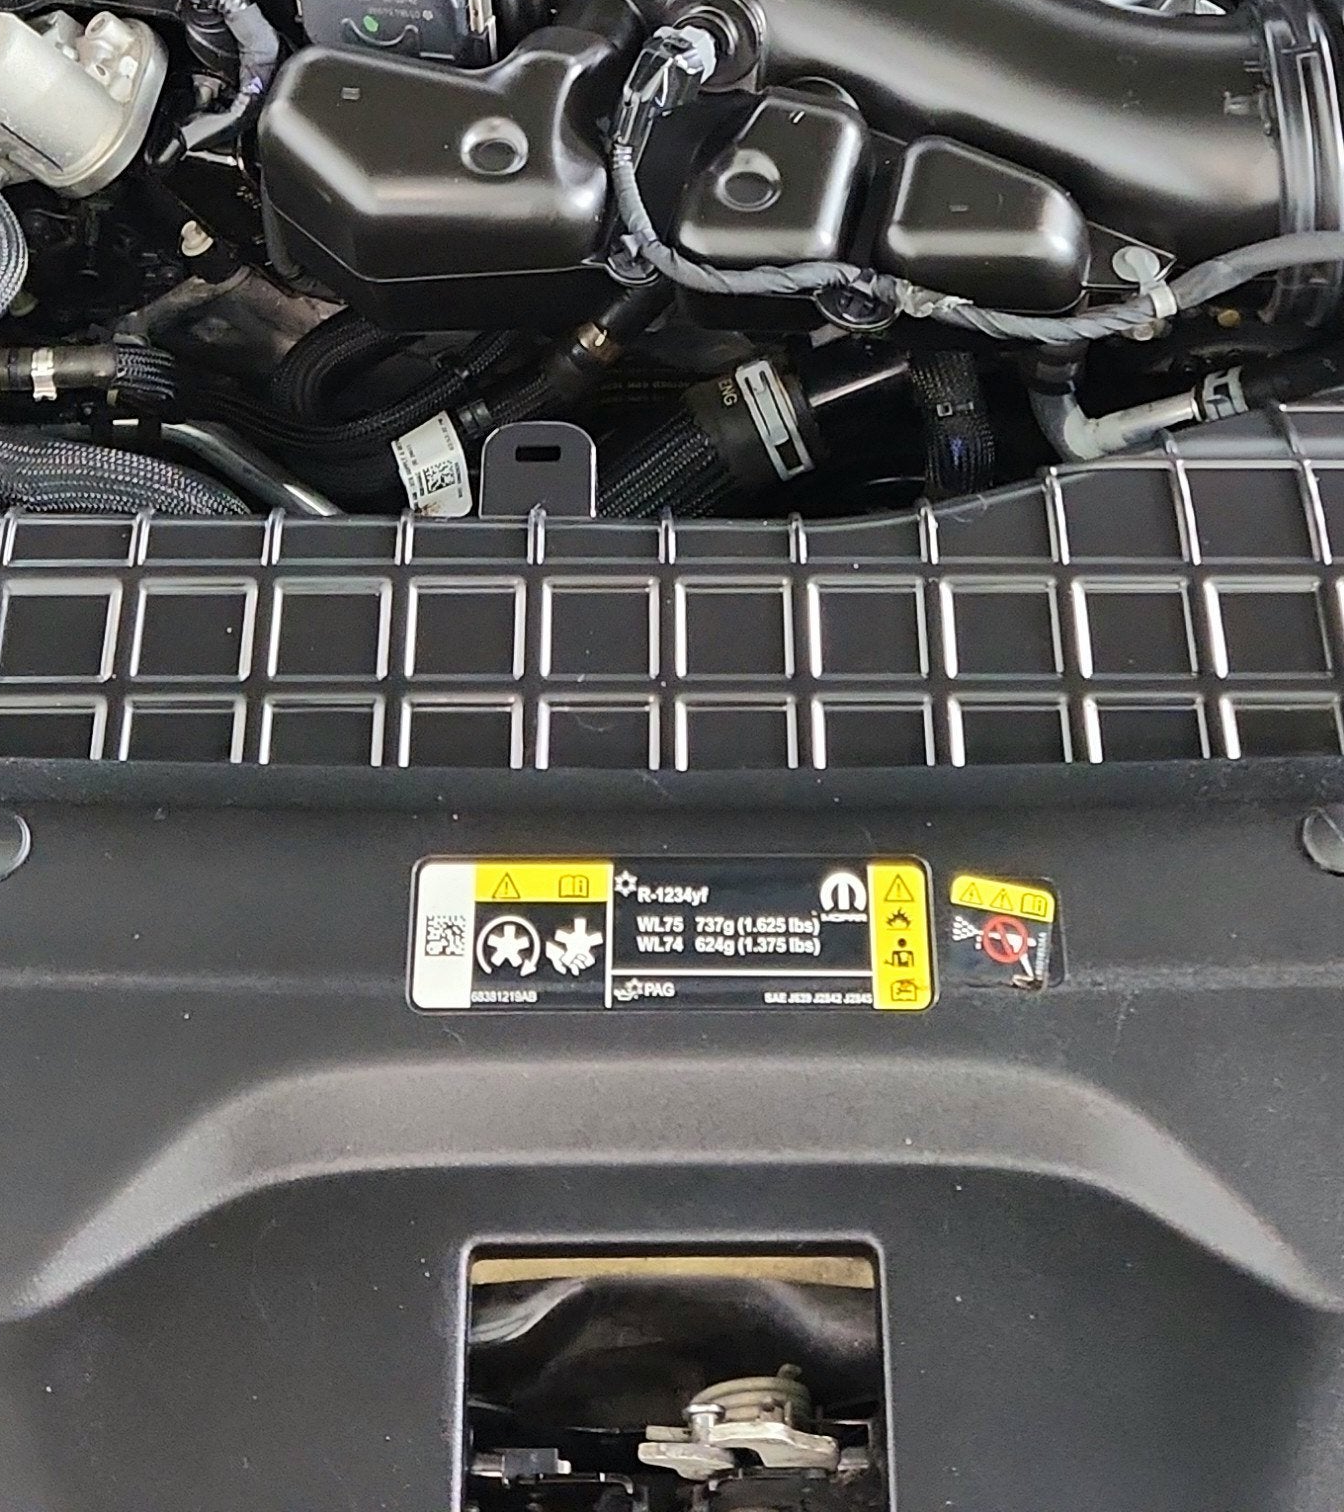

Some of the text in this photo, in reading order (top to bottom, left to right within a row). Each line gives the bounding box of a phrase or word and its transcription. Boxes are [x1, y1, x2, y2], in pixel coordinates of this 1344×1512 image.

[718, 378, 738, 407] ENG
[637, 885, 710, 907] R-1234yf
[636, 915, 820, 936] WL75 737g (1.625 lbs)
[636, 935, 821, 957] WL74 624g (1.375 lbs)
[644, 981, 676, 997] PAG
[764, 992, 787, 1004] SAE
